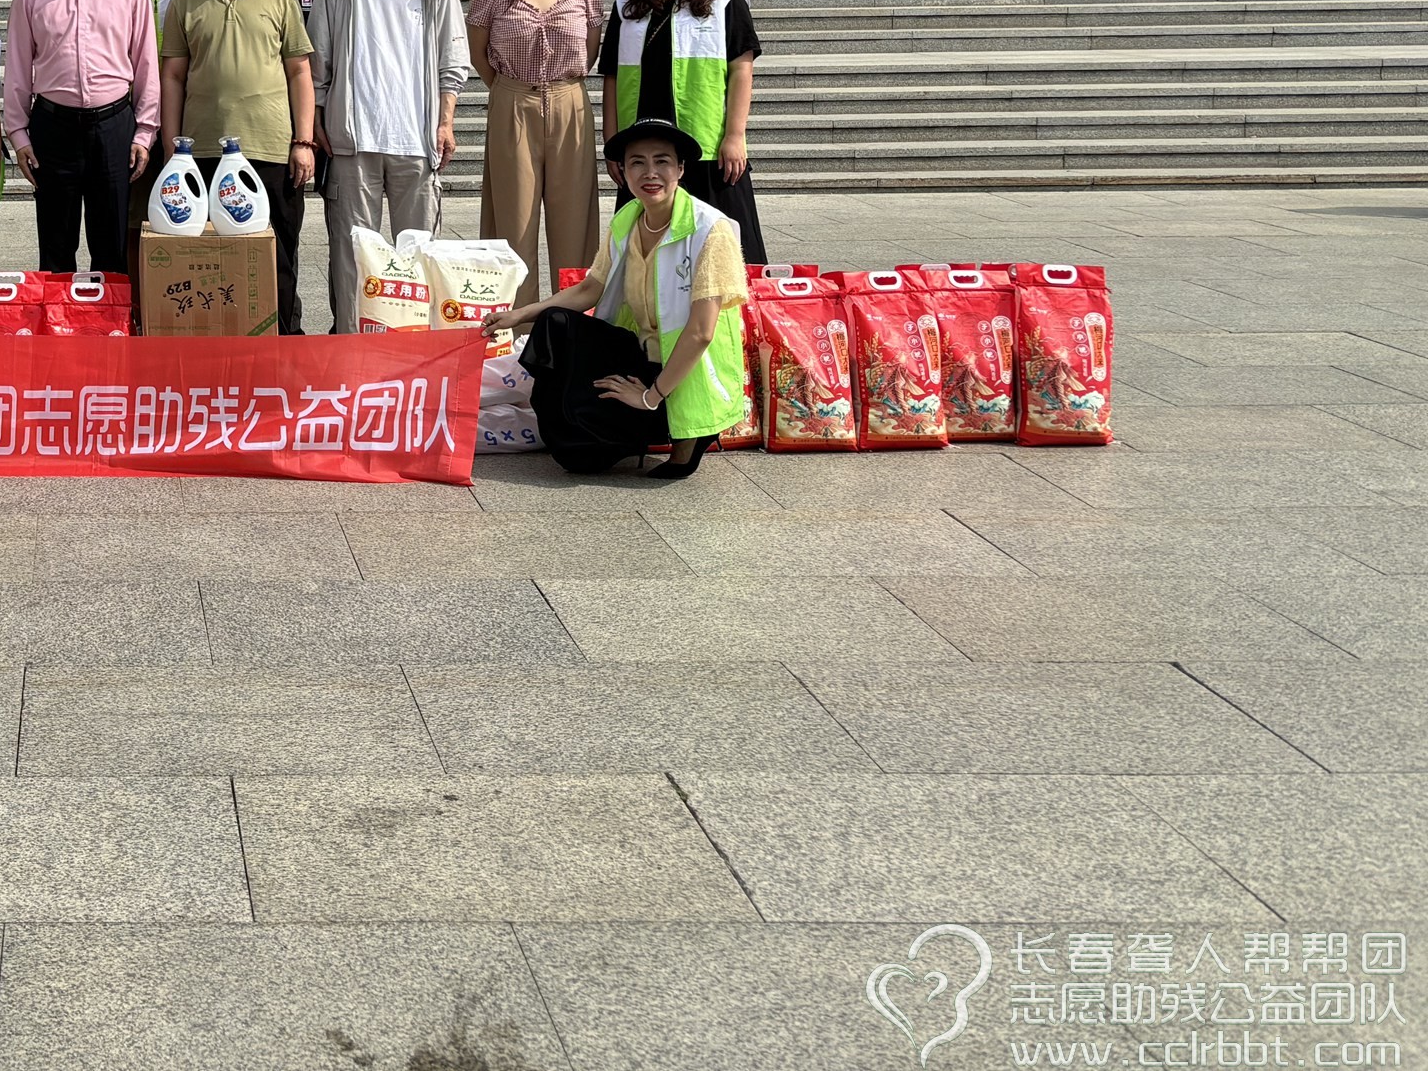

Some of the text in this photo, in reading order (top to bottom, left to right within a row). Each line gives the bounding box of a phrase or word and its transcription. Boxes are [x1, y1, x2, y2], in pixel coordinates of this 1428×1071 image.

[162, 186, 179, 195] B29
[219, 186, 237, 198] B29
[166, 280, 192, 296] B29
[383, 282, 426, 299] 家用粉
[460, 279, 496, 295] 大公
